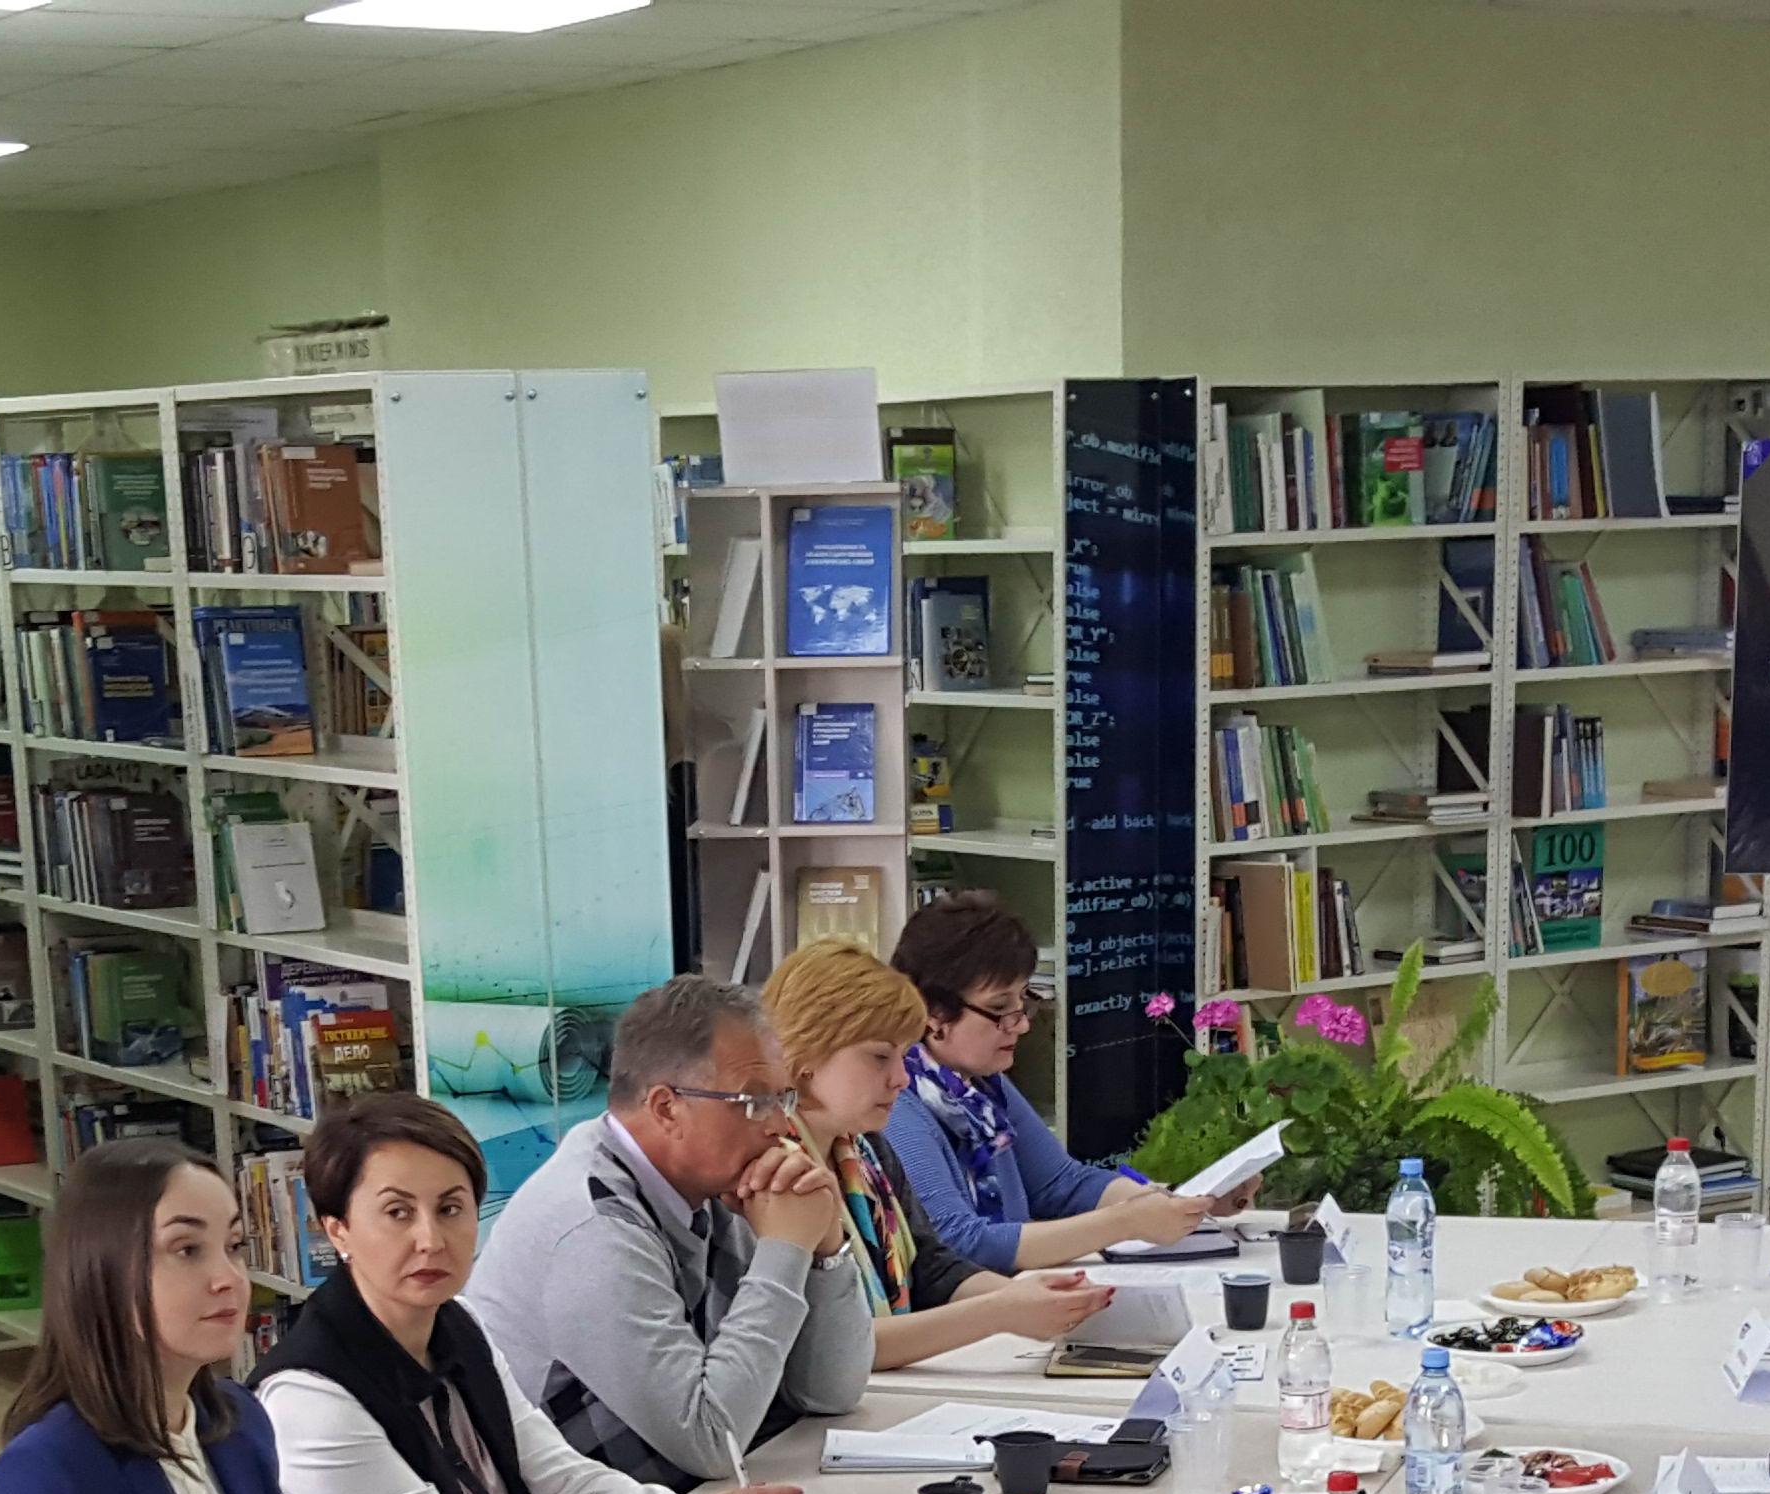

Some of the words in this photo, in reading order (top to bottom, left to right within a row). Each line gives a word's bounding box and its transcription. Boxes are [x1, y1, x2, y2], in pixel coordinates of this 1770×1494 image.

[1123, 813, 1155, 830] back
[1543, 831, 1597, 867] 100
[1074, 993, 1133, 1016] exactly
[334, 1043, 371, 1064] ДЕЛО
